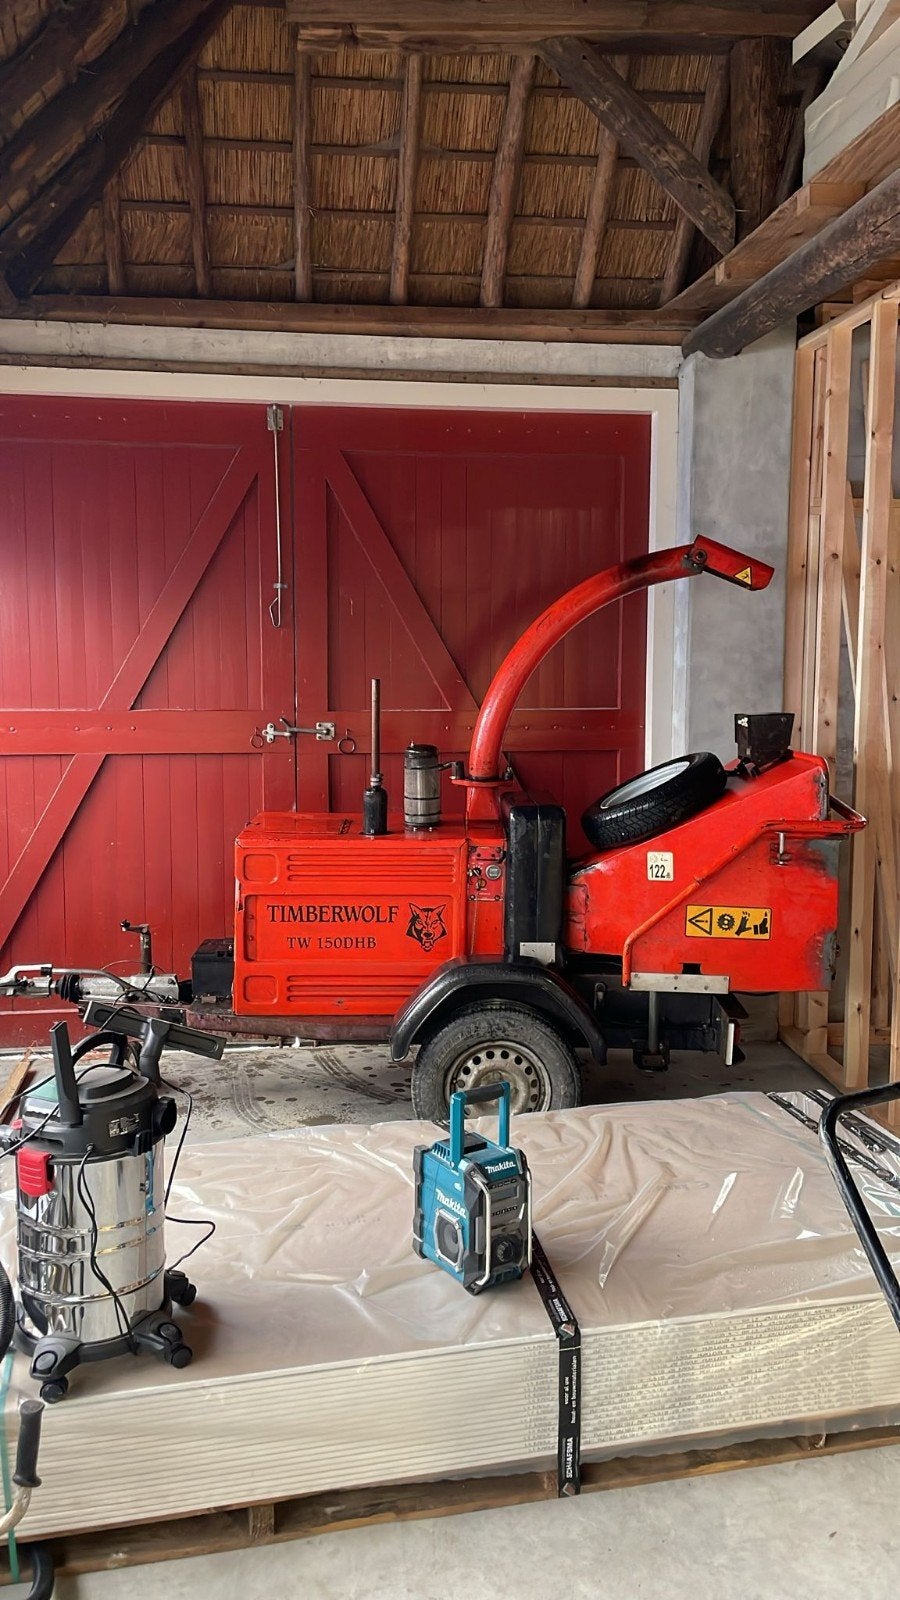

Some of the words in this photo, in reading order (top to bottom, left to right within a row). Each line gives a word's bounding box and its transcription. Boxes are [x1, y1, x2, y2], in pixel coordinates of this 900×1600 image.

[649, 864, 666, 878] 122
[267, 905, 399, 923] TIMBERWOLF
[287, 937, 311, 949] TW
[318, 937, 377, 949] 150DHB
